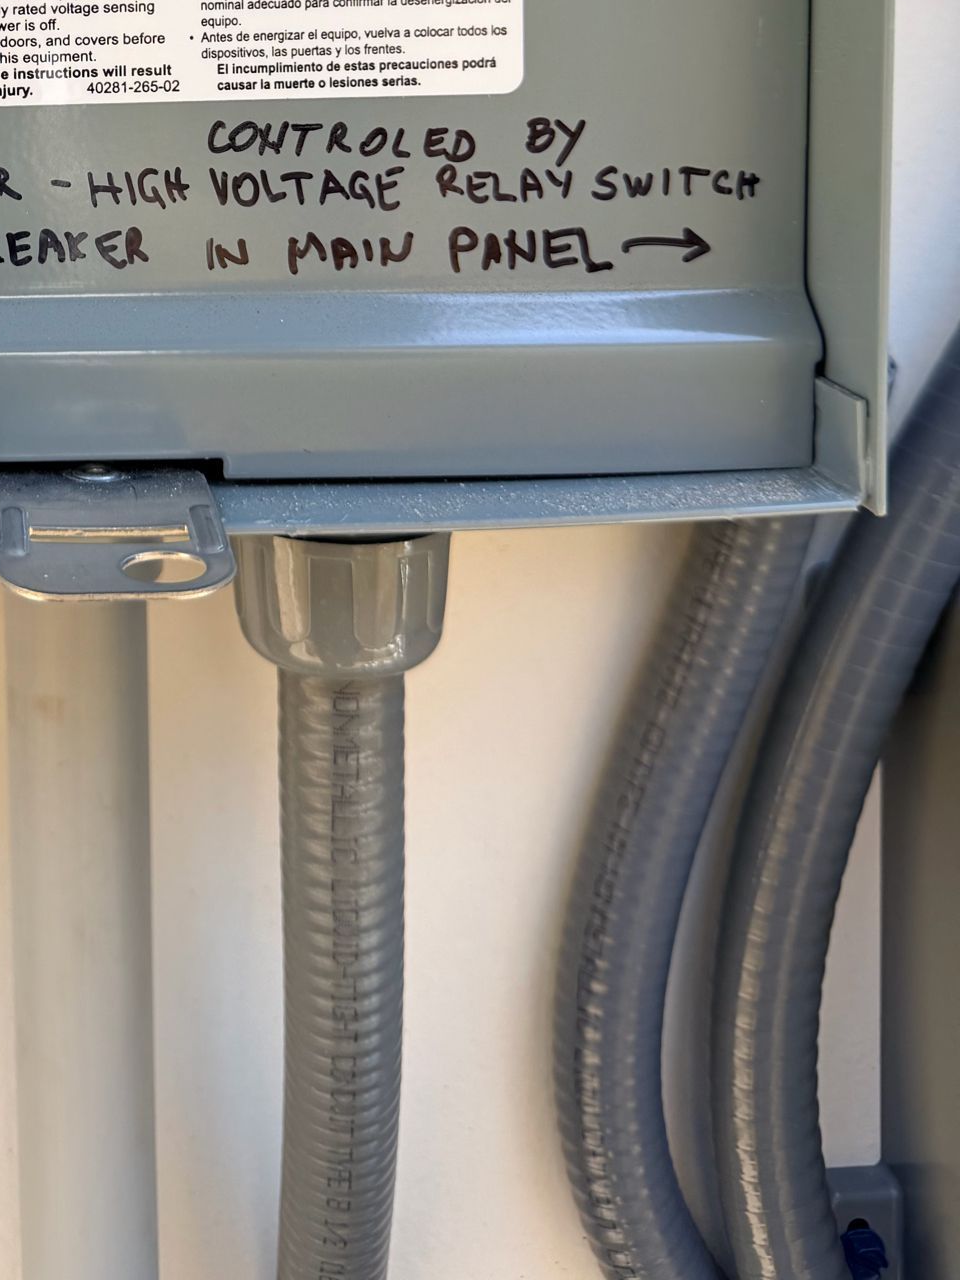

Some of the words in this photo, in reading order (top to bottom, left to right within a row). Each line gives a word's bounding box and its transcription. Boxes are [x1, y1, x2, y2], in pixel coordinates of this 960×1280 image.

[14, 66, 98, 79] instructions
[102, 65, 126, 77] will
[131, 64, 172, 76] result
[87, 80, 180, 94] 40281-265-02
[207, 120, 477, 159] CONTROLED
[525, 116, 587, 166] BY
[88, 166, 190, 209] HIGH
[209, 166, 405, 211] VOLTAGE
[437, 163, 572, 203] RELAY
[591, 165, 759, 201] SWITCH
[206, 236, 250, 269] IN
[288, 231, 413, 274] MAIN
[448, 226, 615, 273] PANEL
